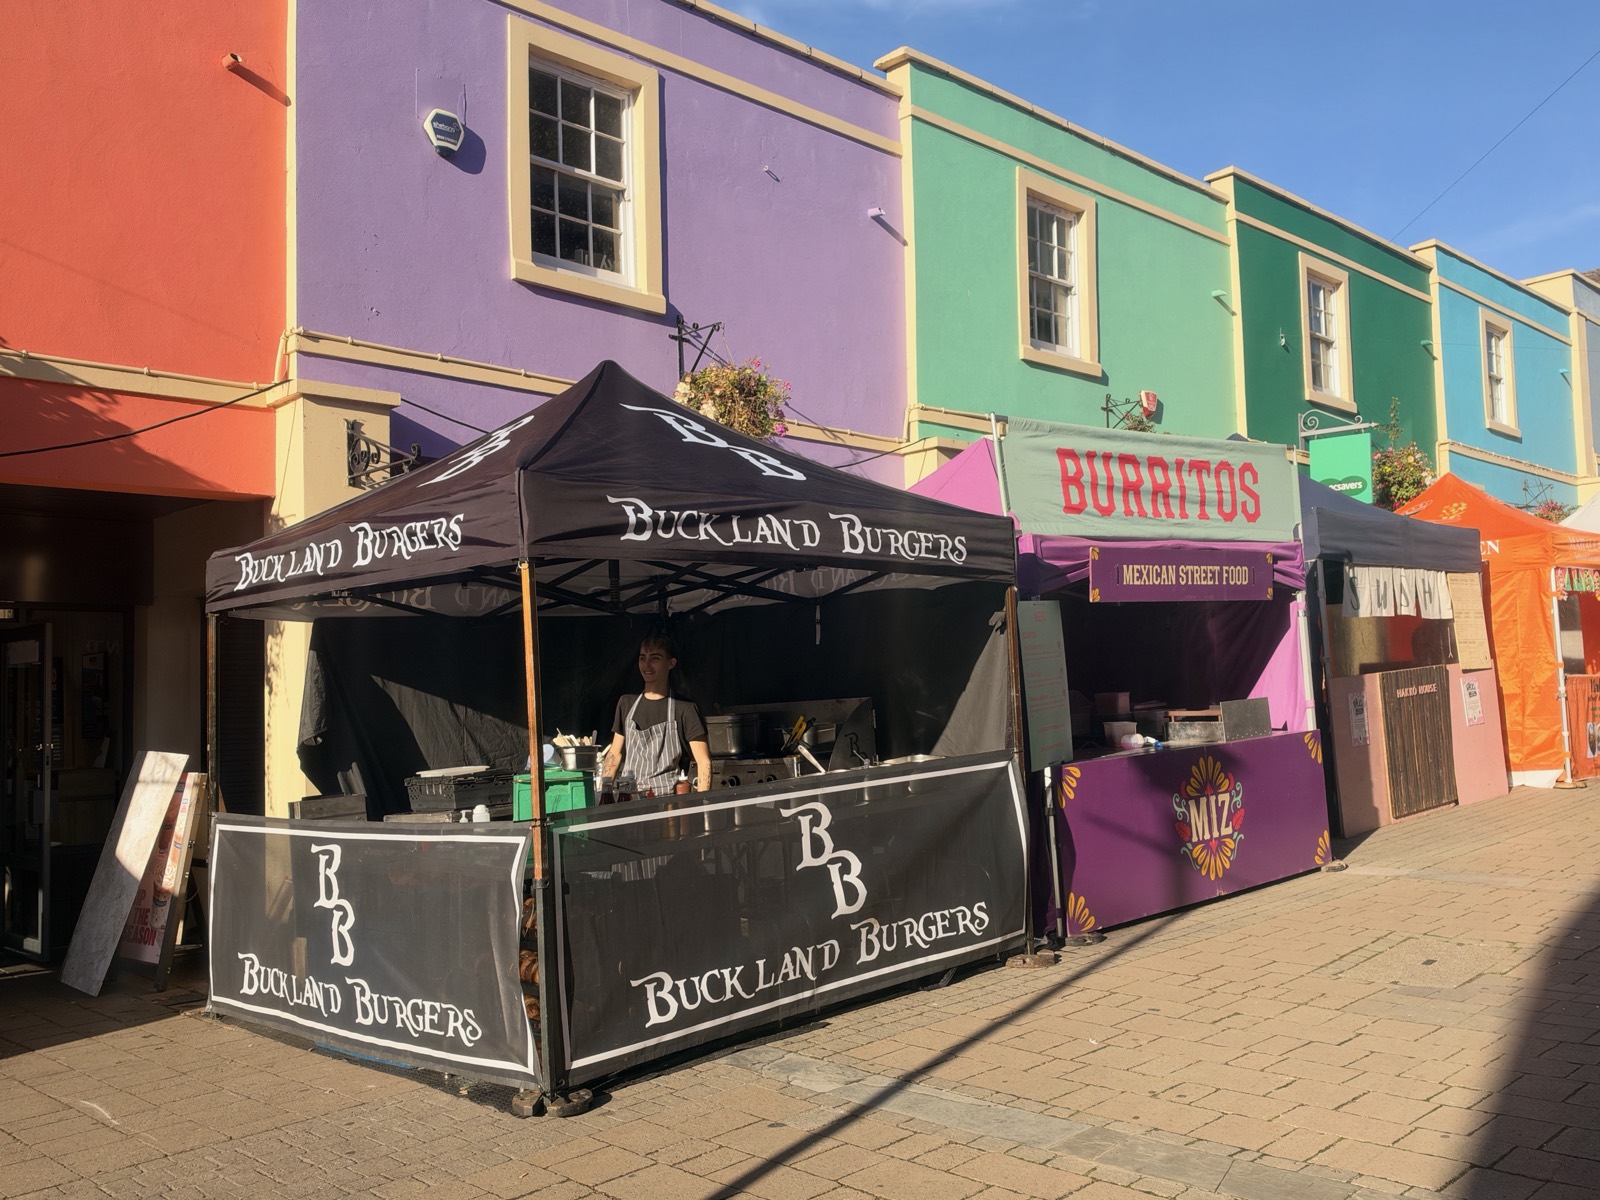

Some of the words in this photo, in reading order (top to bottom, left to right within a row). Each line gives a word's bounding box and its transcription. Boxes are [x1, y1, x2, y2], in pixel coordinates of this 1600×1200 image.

[1055, 447, 1262, 523] BURRITOS
[349, 513, 465, 568] BURGERS
[829, 512, 968, 565] BURGERS
[1123, 564, 1176, 586] MEXICAN
[1178, 565, 1220, 586] STREET
[1222, 566, 1249, 585] FOOD
[1349, 575, 1452, 611] SUSH
[1418, 683, 1438, 695] HOUSE
[1188, 792, 1233, 843] MIZ
[850, 901, 991, 966] BURGERS
[345, 976, 483, 1048] BURGERS
